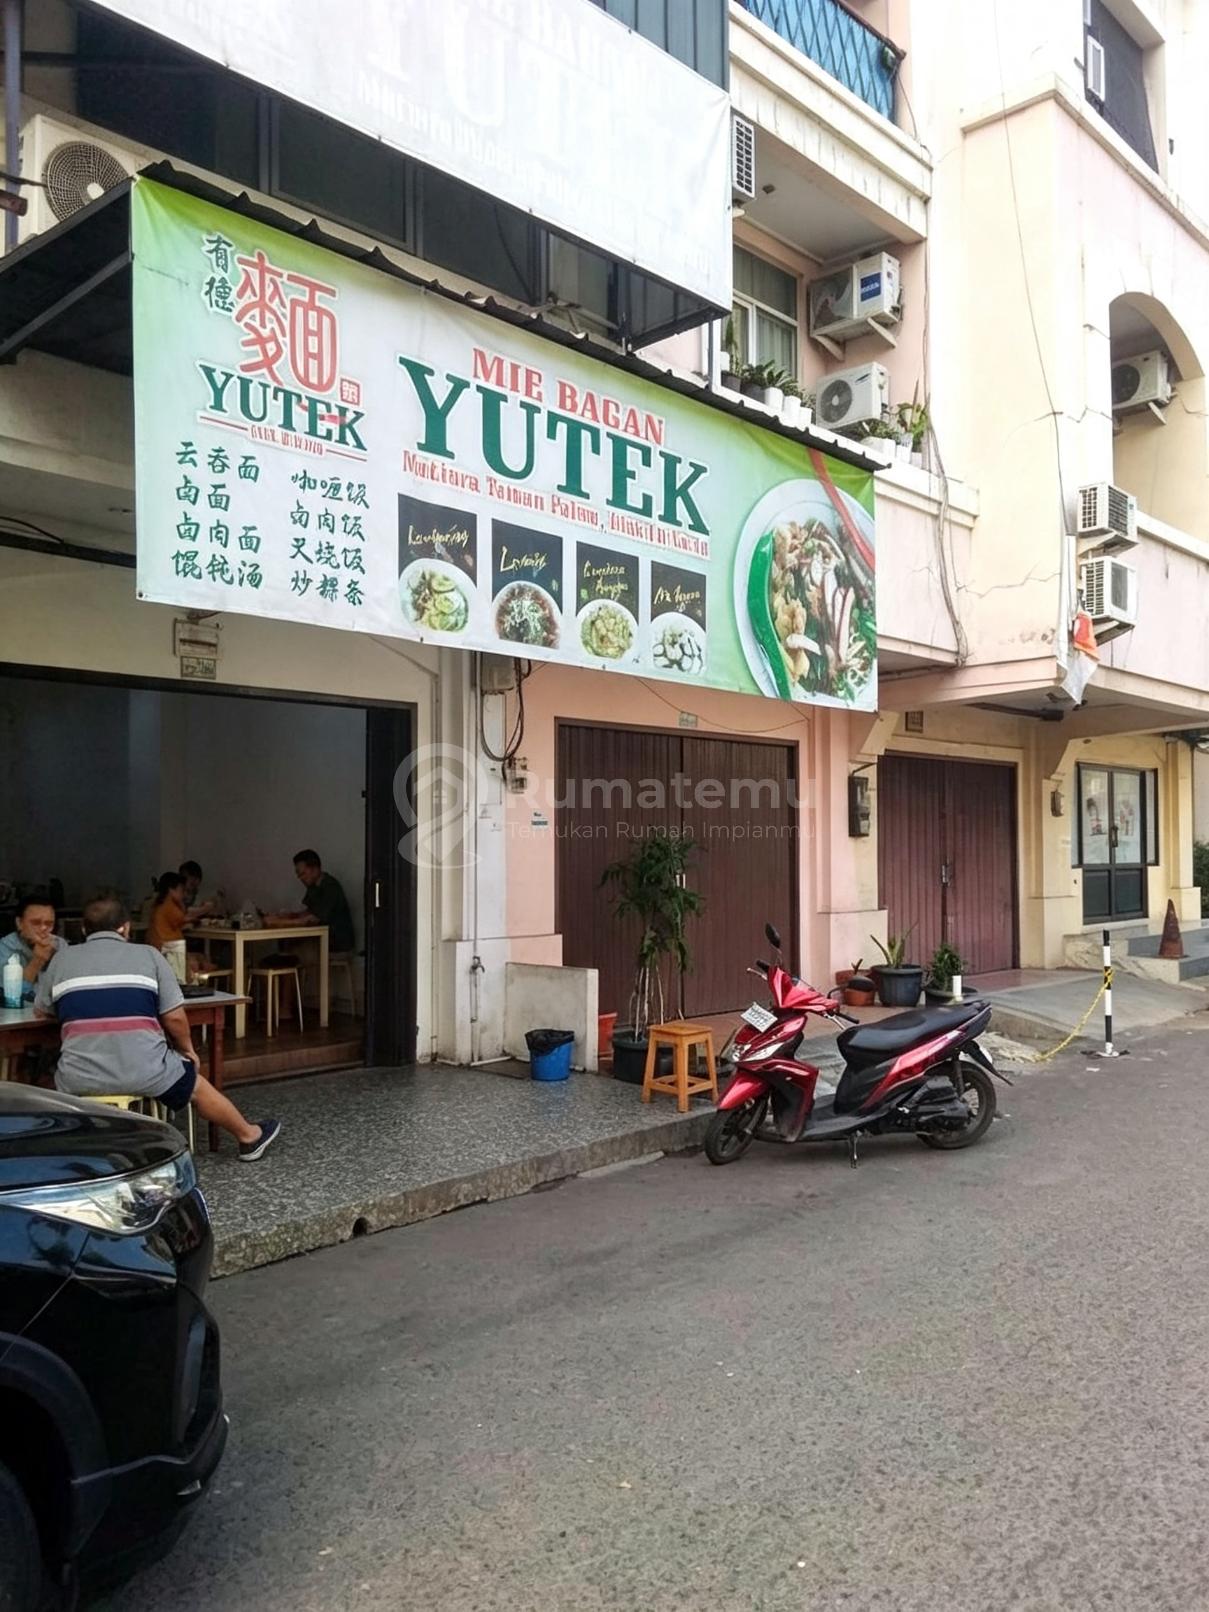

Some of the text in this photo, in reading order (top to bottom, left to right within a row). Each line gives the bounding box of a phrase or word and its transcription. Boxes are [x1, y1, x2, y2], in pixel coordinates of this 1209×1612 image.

[199, 363, 368, 452] YUTEK
[473, 348, 665, 446] MIE BAGAN
[175, 441, 260, 484] 云吞面
[398, 355, 710, 537] YUTEK
[175, 474, 231, 512] 卤面
[175, 511, 262, 554] 卤肉面
